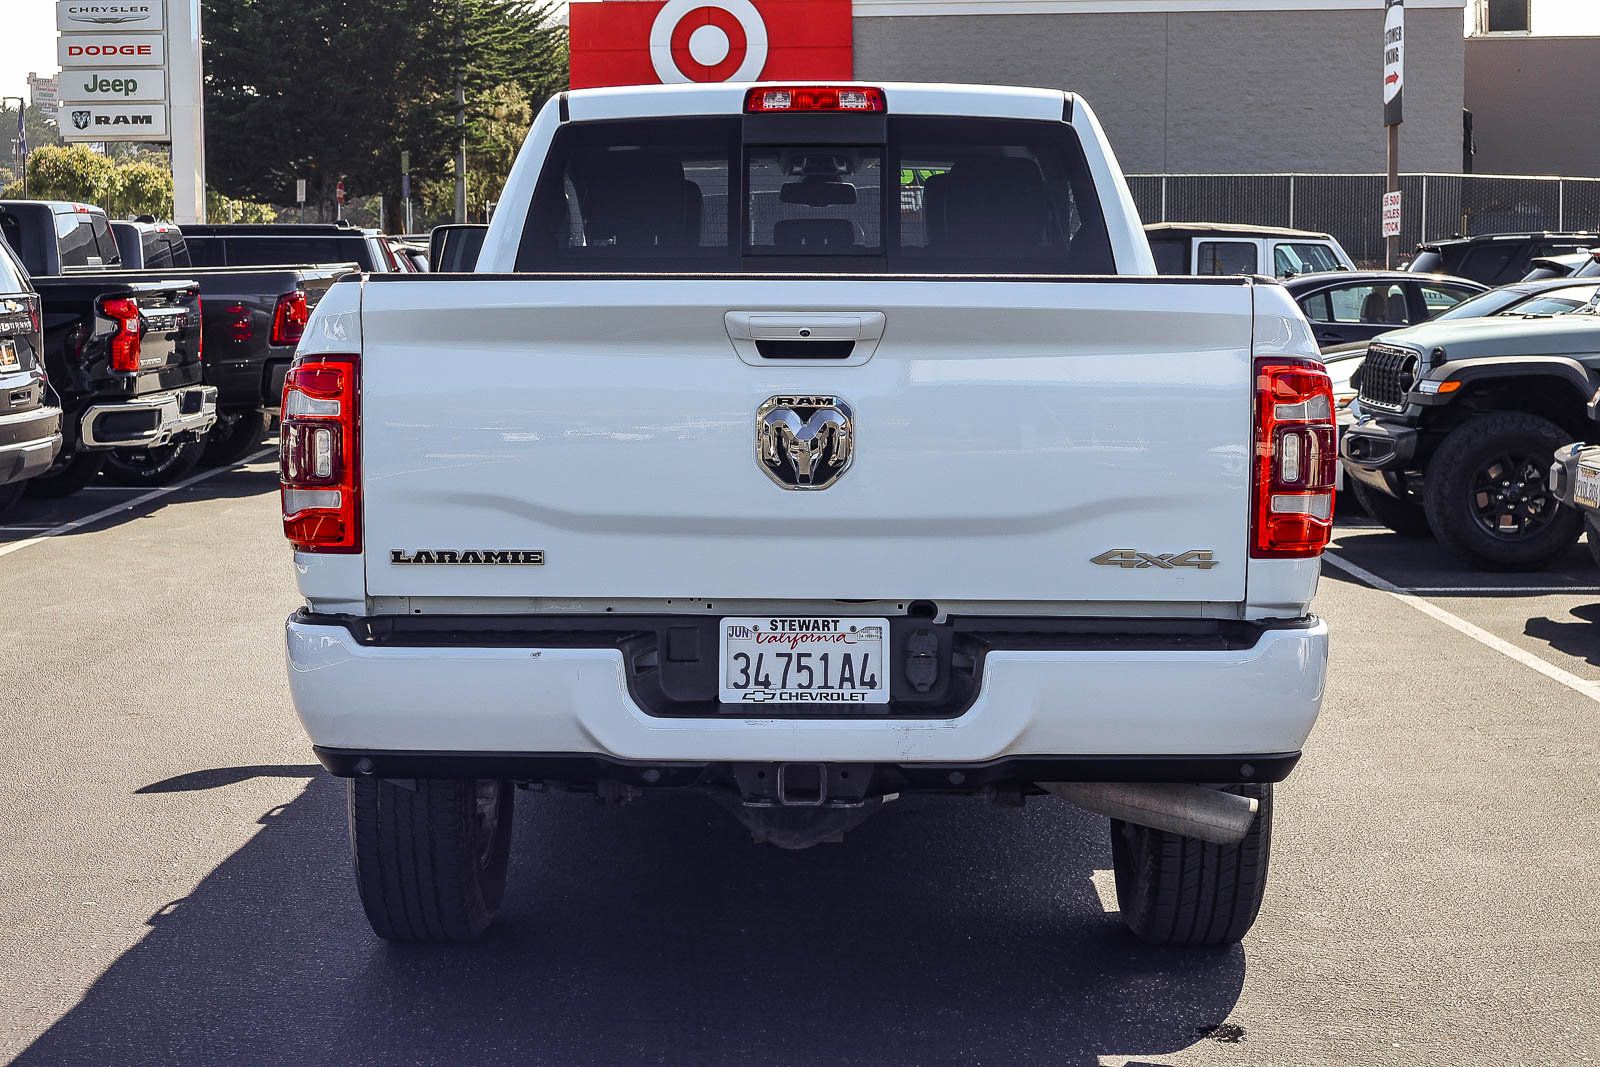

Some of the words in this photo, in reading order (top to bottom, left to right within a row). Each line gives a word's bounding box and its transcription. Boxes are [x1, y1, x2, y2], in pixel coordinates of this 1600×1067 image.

[68, 45, 151, 56] DODGE
[84, 74, 137, 96] Jeep
[95, 115, 152, 125] RAM
[776, 397, 834, 406] RAM
[391, 549, 545, 565] LARAMIE
[1089, 548, 1219, 569] 4x4
[770, 619, 840, 632] STEWART
[728, 627, 749, 638] JUN
[756, 632, 857, 650] California
[732, 652, 877, 689] 34751A4
[779, 691, 868, 701] CHEVROLET
